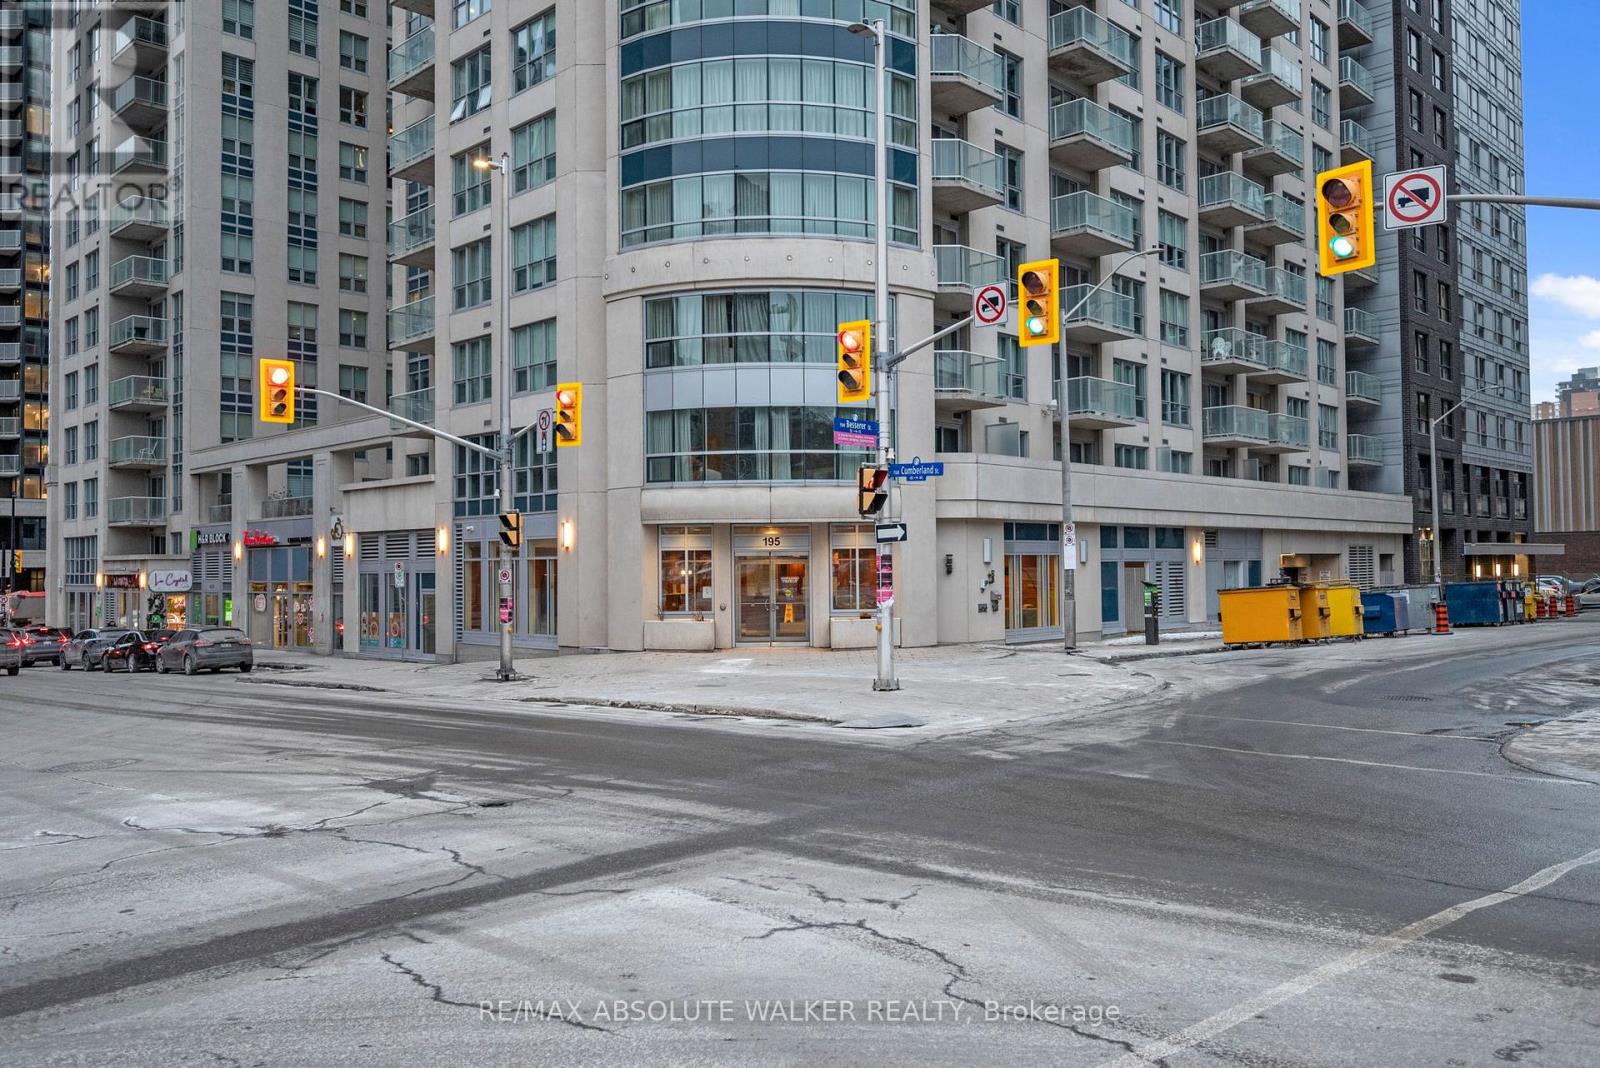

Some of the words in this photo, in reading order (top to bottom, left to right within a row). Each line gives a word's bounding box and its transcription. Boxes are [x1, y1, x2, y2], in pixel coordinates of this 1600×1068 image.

[846, 419, 866, 430] Besserer
[901, 465, 934, 474] Cumberland
[762, 537, 780, 546] 195
